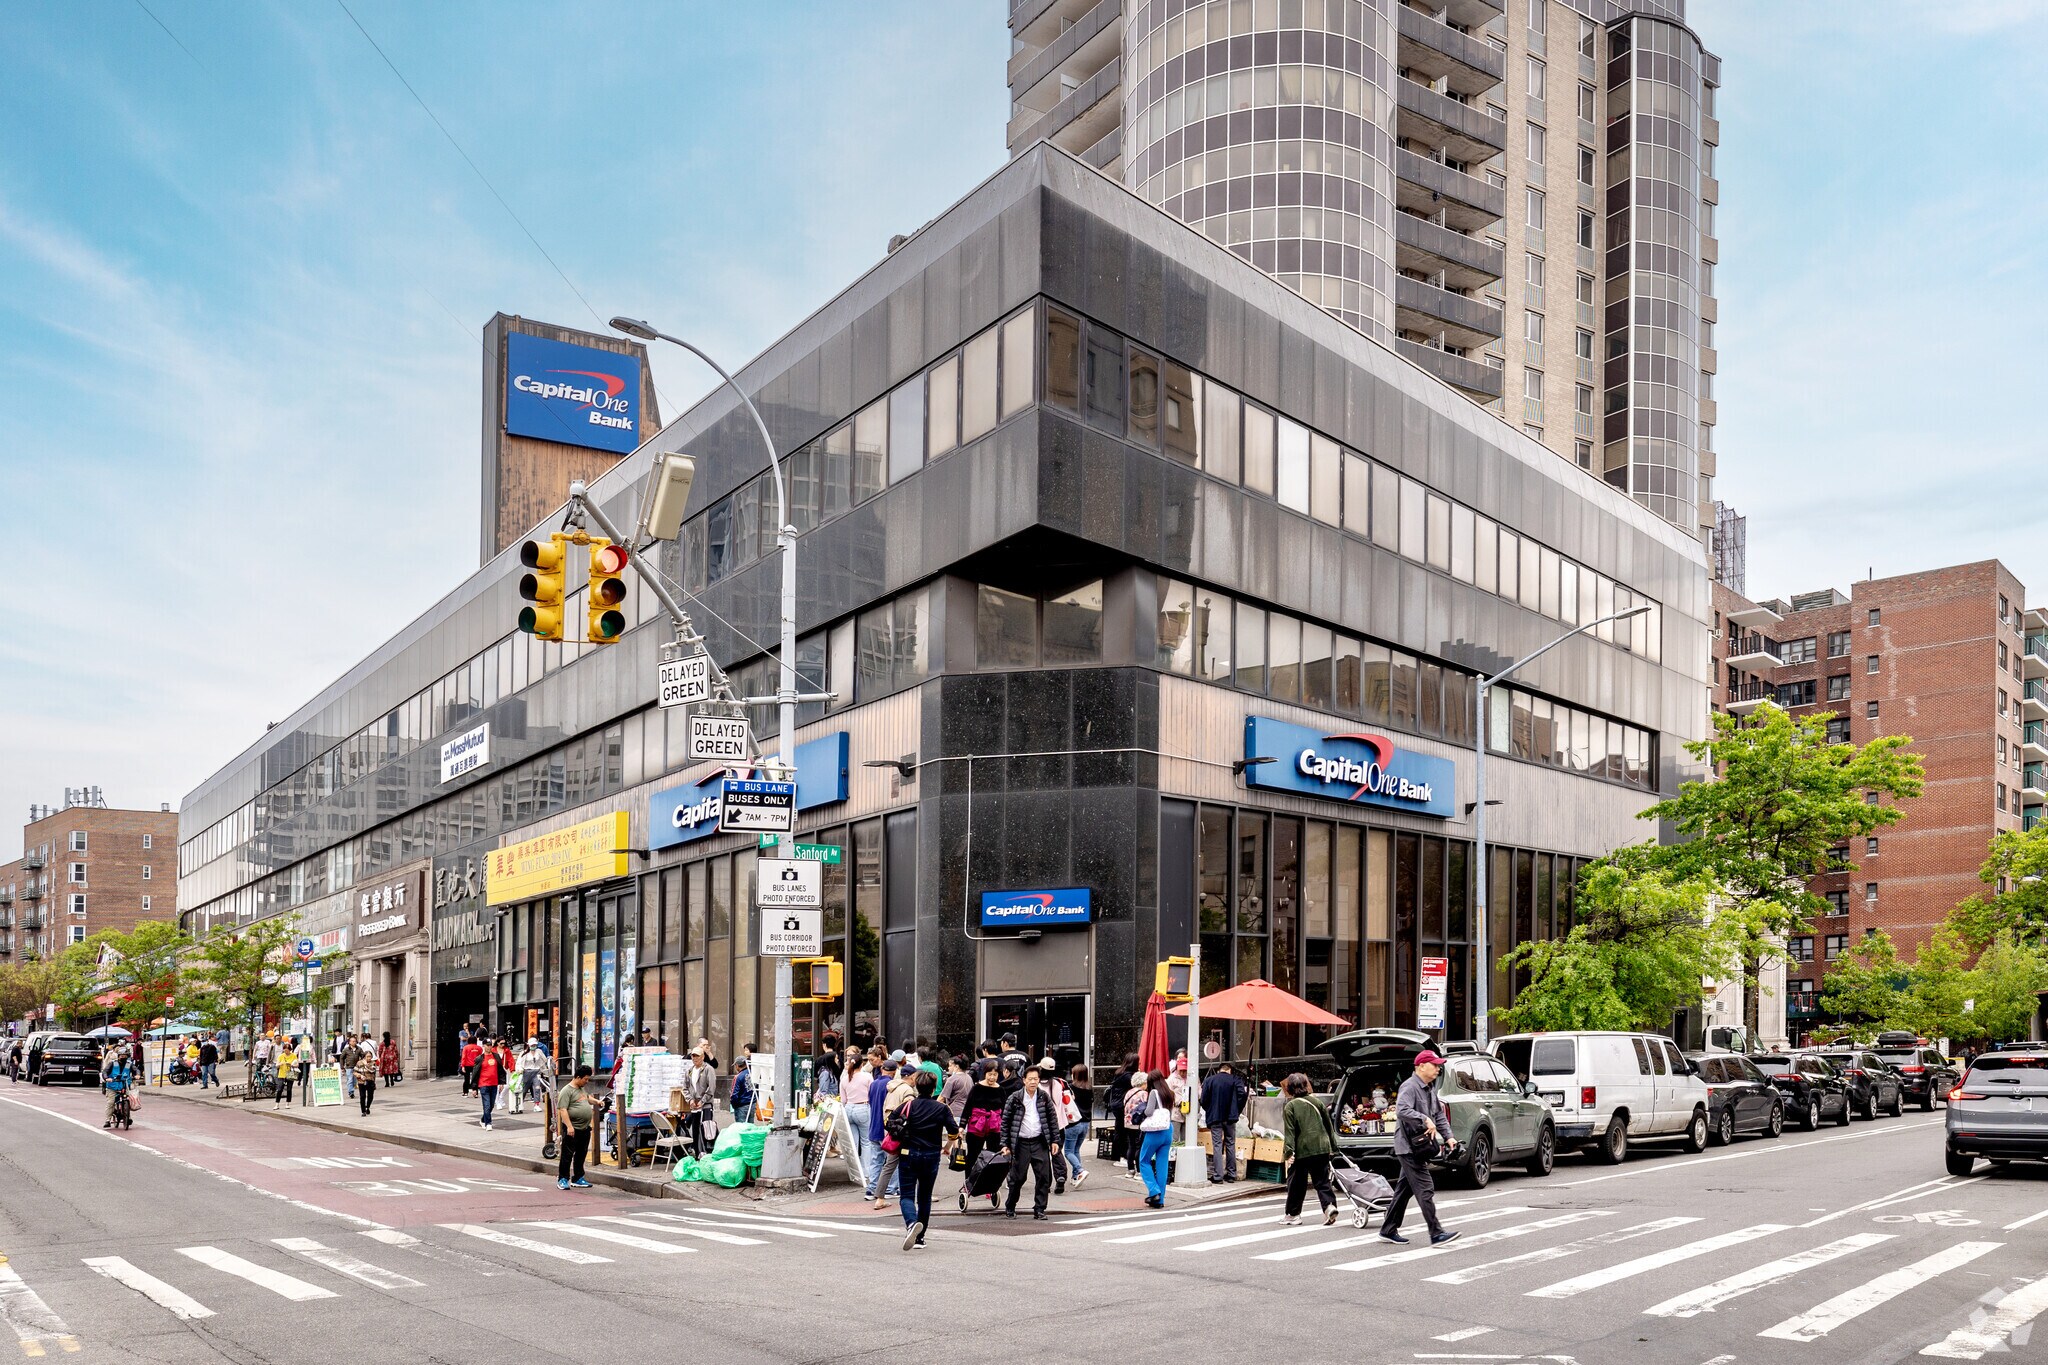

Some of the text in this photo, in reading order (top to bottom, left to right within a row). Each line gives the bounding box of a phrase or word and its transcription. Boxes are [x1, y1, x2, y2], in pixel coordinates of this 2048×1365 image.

[513, 375, 629, 413] Capital One
[589, 411, 633, 430] Bank
[661, 661, 705, 684] DELAYED
[663, 680, 704, 701] GREEN
[694, 722, 745, 738] DELAYED
[695, 740, 743, 755] GREEN
[1299, 749, 1433, 802] Capital One Bank
[744, 782, 788, 793] BUS LANE
[728, 794, 788, 805] BUSES ONLY
[672, 796, 721, 829] Capita
[745, 813, 762, 822] 7AM
[770, 814, 787, 823] 7PM
[795, 845, 838, 860] Sanford Av
[772, 884, 807, 892] BUS LANES
[763, 894, 816, 903] PHOTO ENFORCED
[985, 903, 1085, 917] Capital One Bank
[432, 909, 479, 951] LANDMARK
[783, 934, 813, 942] CORRIDOR
[786, 945, 817, 953] ENFORCED
